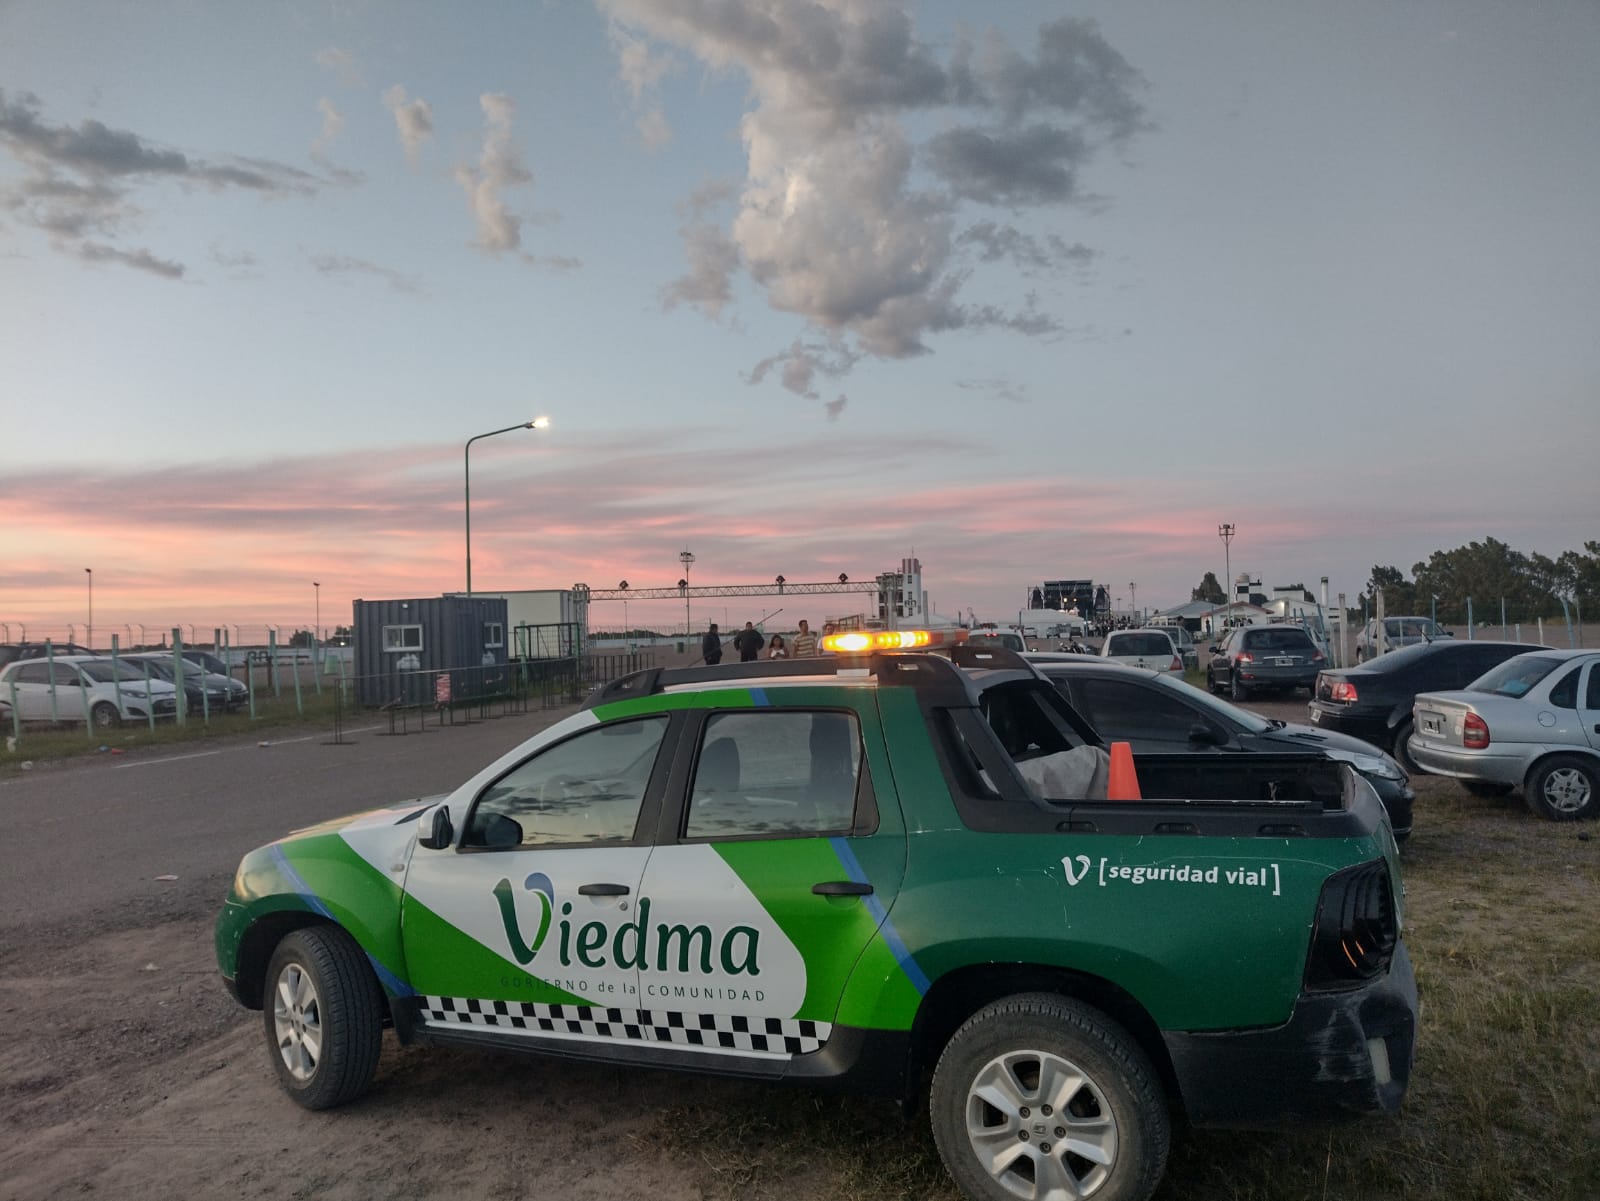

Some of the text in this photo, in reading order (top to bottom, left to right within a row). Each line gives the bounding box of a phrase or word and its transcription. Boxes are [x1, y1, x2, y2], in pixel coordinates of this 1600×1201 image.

[492, 872, 761, 976] Viedma
[500, 976, 765, 1002] GOBIERNO de la COMUNIDAD
